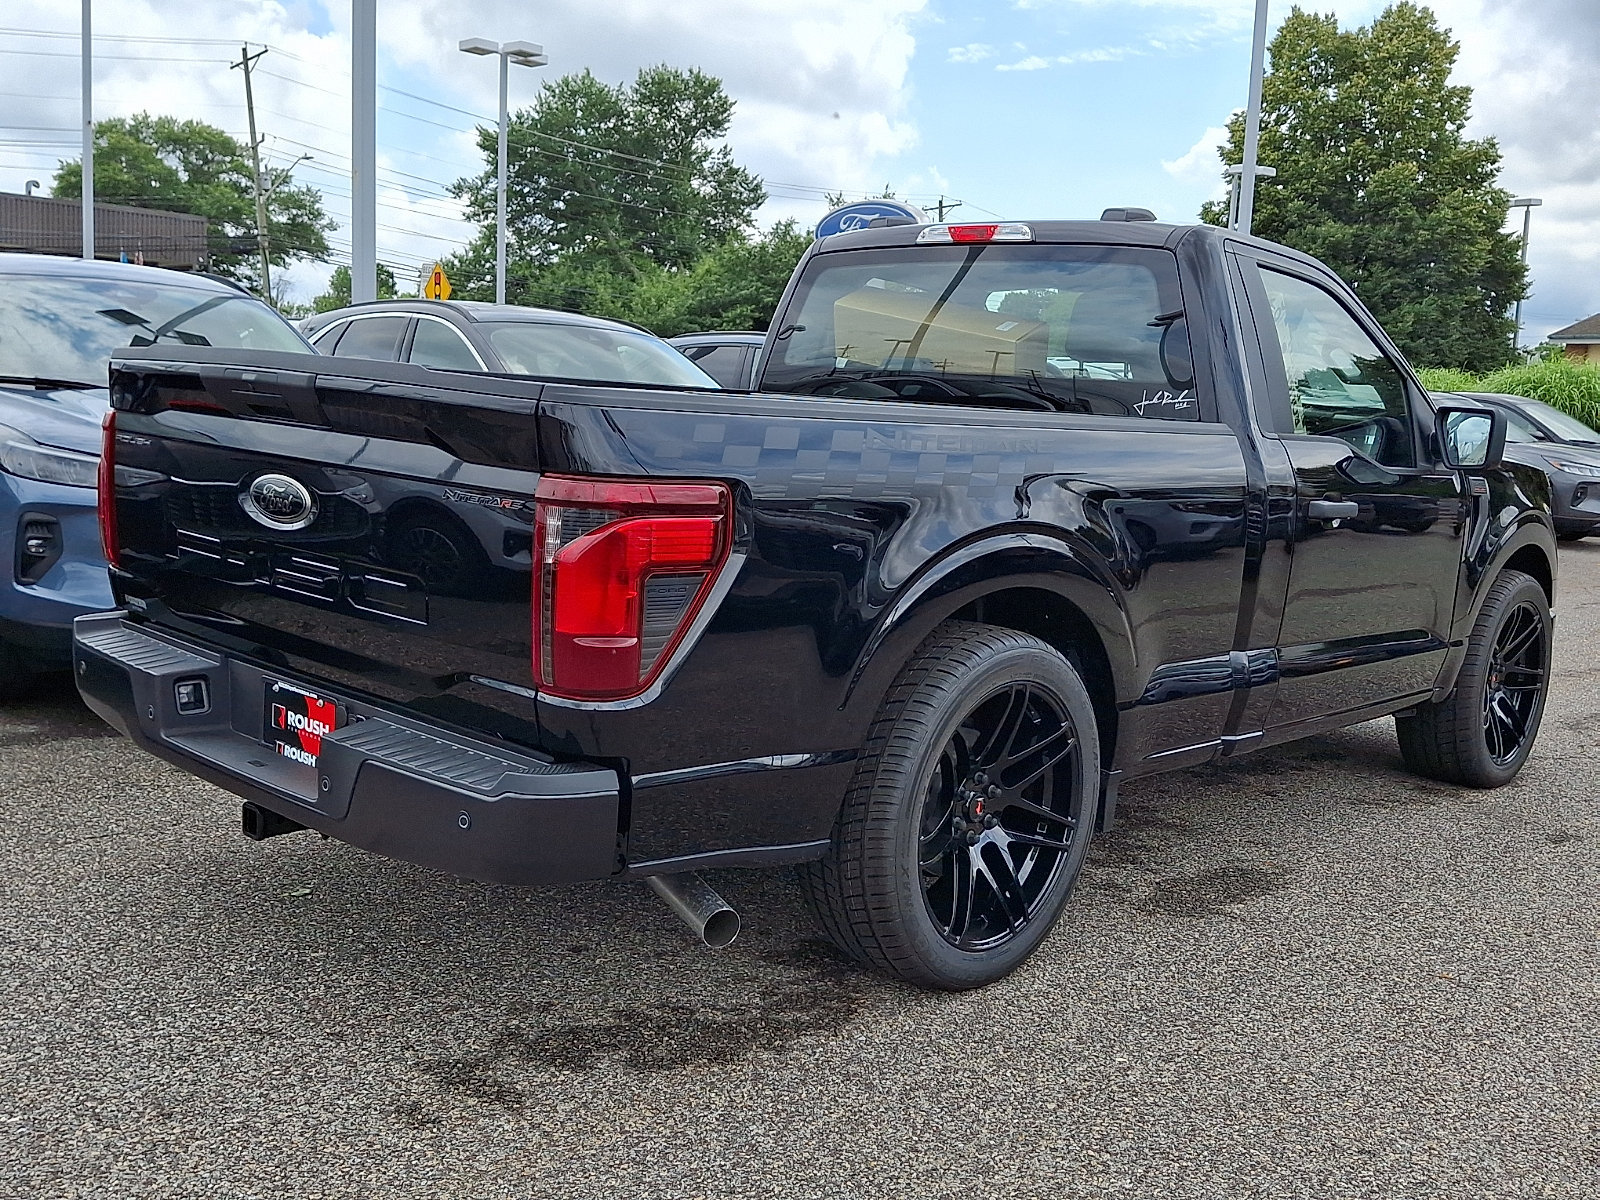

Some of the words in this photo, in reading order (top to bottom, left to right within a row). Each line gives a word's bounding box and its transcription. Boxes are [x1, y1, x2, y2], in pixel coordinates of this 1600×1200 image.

[260, 483, 294, 513] Ford
[287, 710, 330, 736] ROUSH
[284, 744, 318, 768] ROUSH
